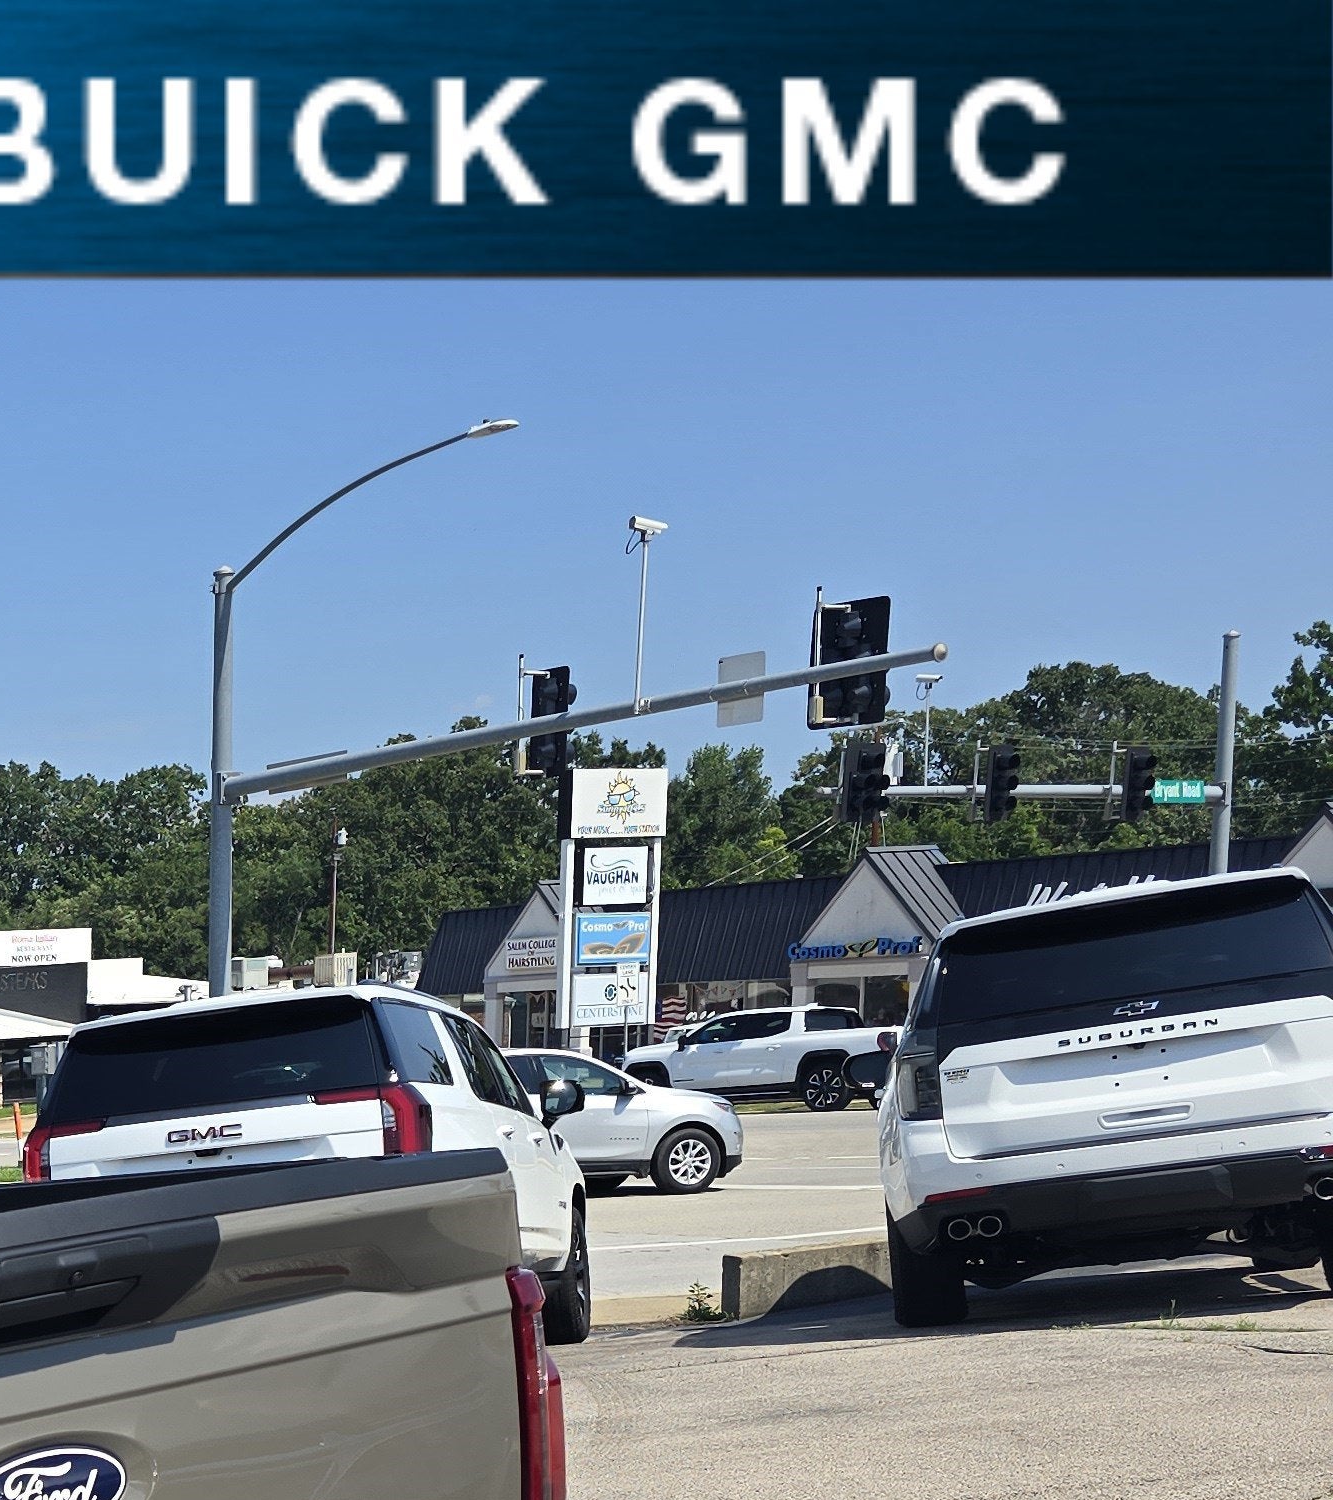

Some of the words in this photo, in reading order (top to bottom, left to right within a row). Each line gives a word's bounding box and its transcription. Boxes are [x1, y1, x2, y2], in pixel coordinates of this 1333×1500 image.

[1154, 780, 1180, 801] Bryant
[586, 869, 639, 885] VAUGHAN
[581, 921, 614, 933] Cosmo
[628, 919, 650, 932] Prof
[34, 953, 57, 962] OPEN
[787, 942, 847, 961] Cosmo
[877, 935, 923, 956] Prof
[1057, 1018, 1219, 1048] SUBURBAN
[166, 1123, 243, 1144] GMC
